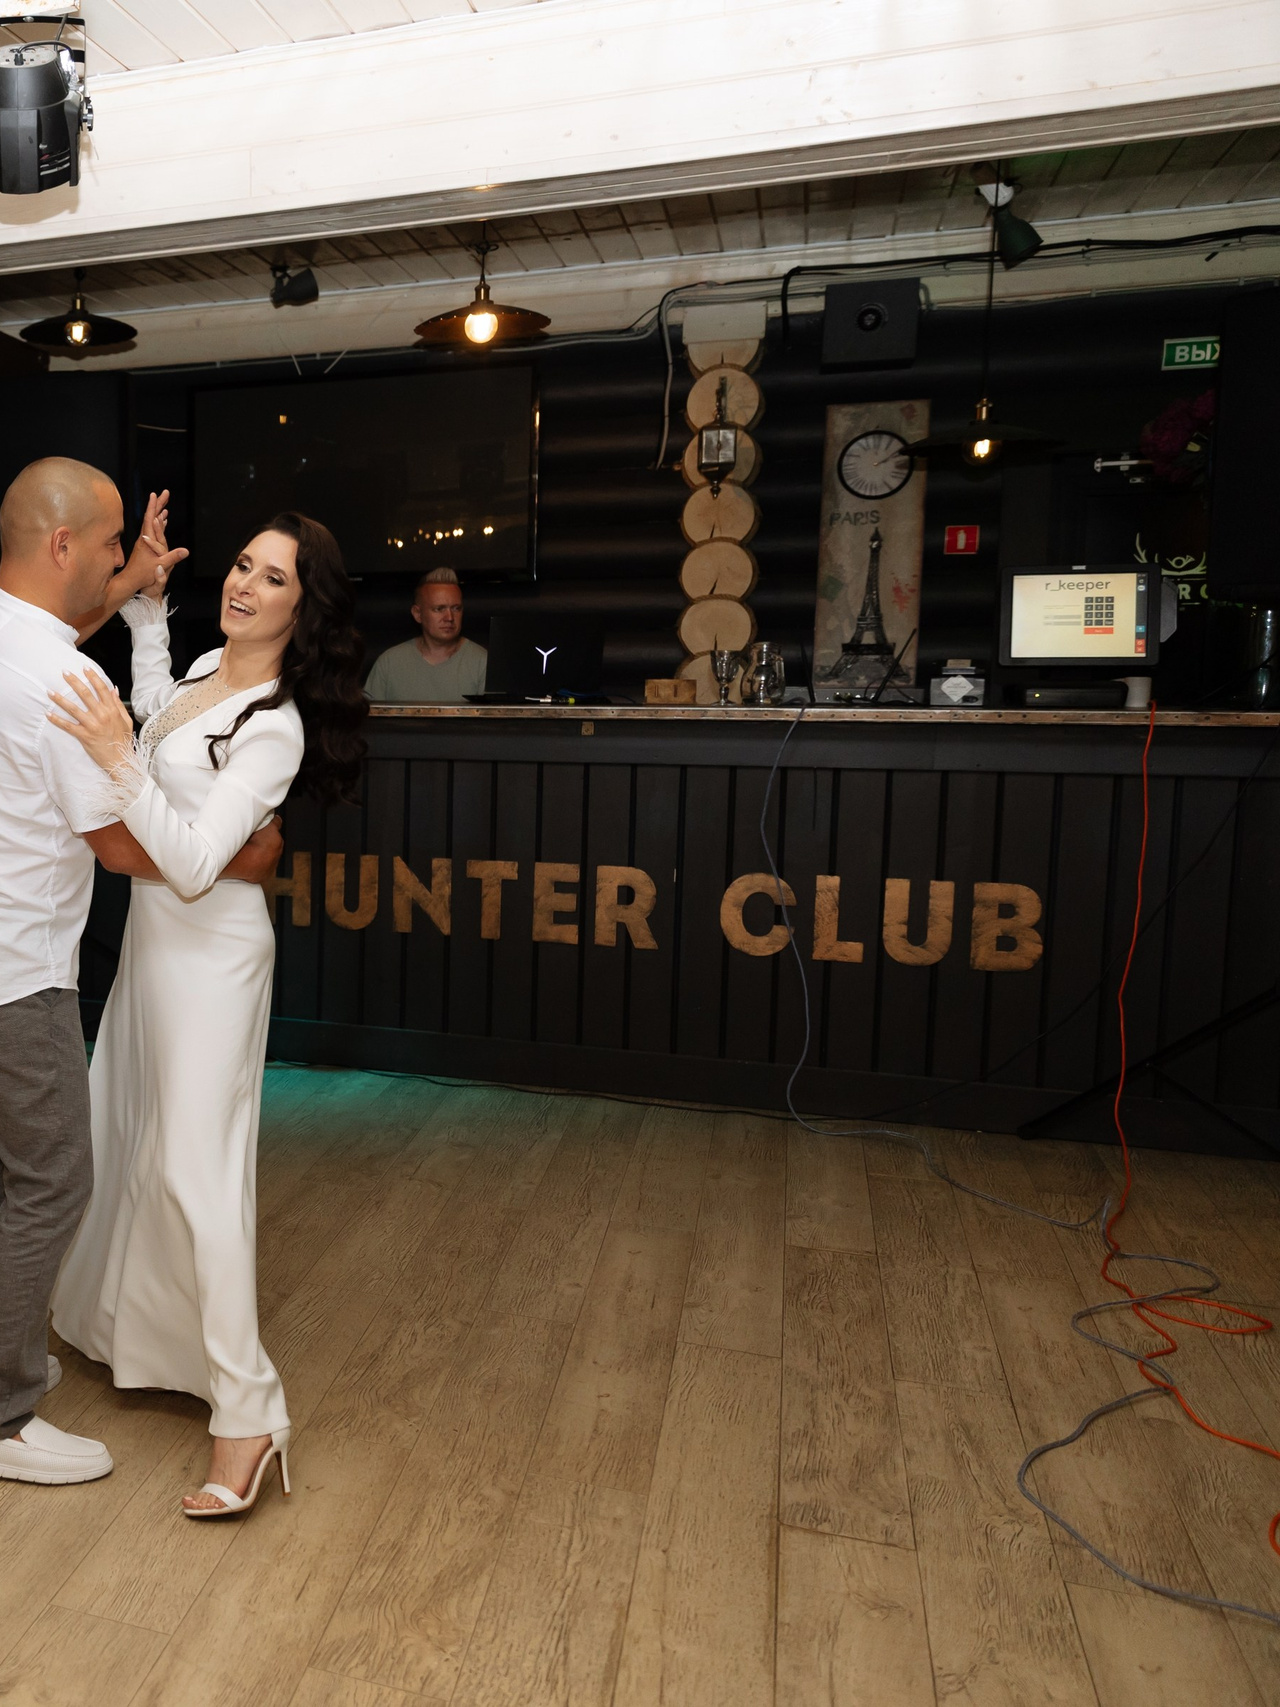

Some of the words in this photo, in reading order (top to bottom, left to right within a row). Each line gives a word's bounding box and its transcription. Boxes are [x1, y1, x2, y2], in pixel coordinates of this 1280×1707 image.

[829, 510, 880, 527] PARIS
[1045, 580, 1111, 592] r_keeper
[266, 851, 658, 949] HUNTER
[720, 872, 1043, 972] CLUB
